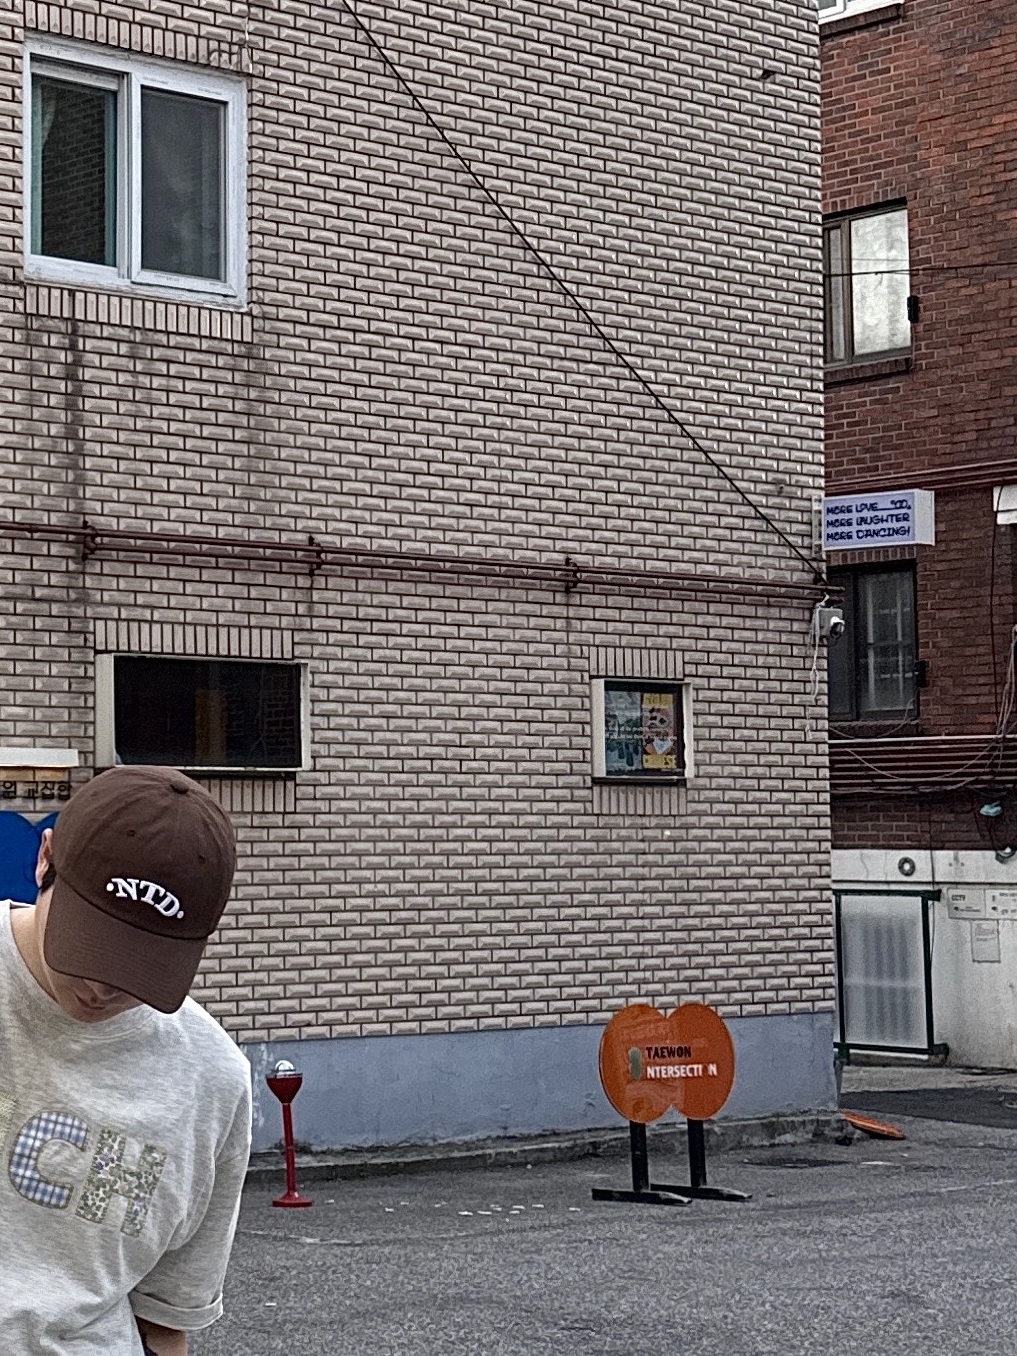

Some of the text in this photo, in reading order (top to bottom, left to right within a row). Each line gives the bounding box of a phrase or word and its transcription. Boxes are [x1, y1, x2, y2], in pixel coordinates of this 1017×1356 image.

[826, 505, 853, 515] MORE
[826, 513, 910, 528] MORE LAUGHTER
[826, 526, 911, 541] MORE DANCING!
[22, 780, 73, 801] 교집합
